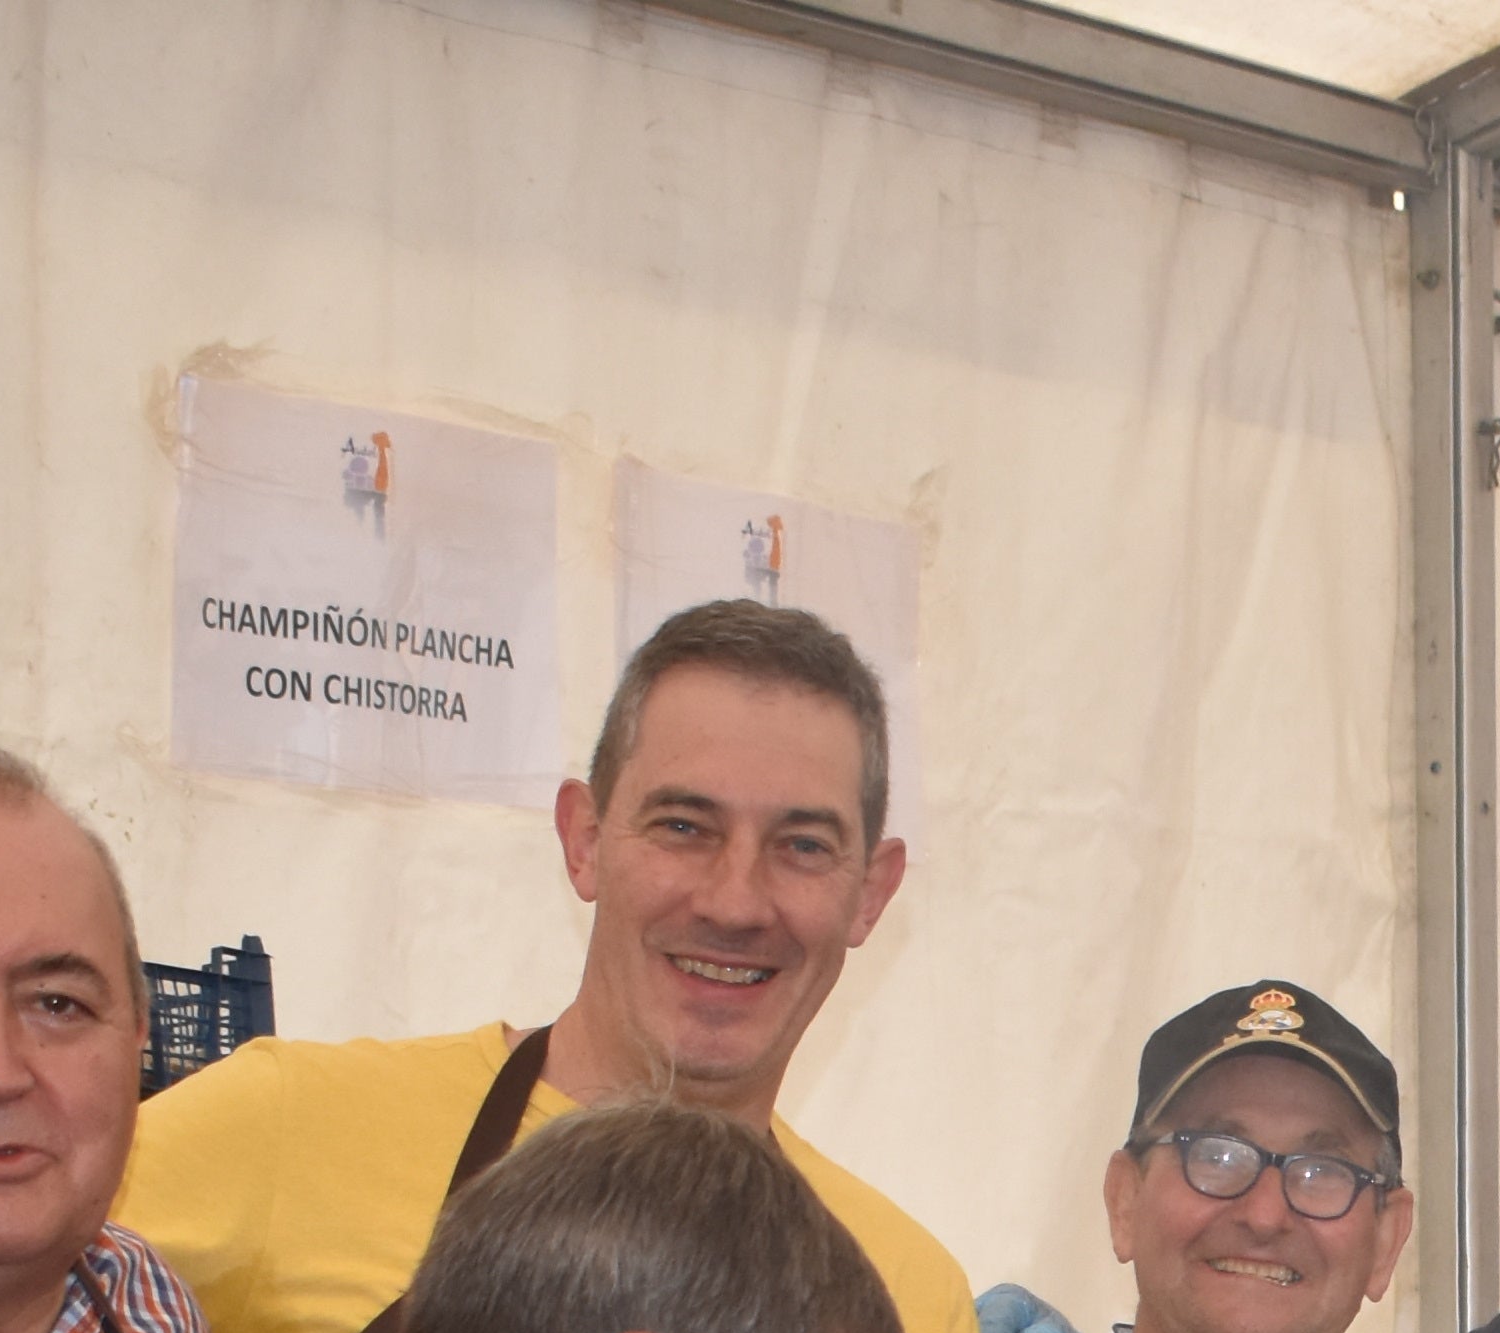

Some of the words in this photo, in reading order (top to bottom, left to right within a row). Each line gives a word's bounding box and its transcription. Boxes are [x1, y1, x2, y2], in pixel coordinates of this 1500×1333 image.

[201, 597, 388, 650] CHAMPIÑÓN
[395, 621, 515, 669] PLANCHA
[245, 665, 312, 702] CON
[323, 673, 468, 723] CHISTORRA
